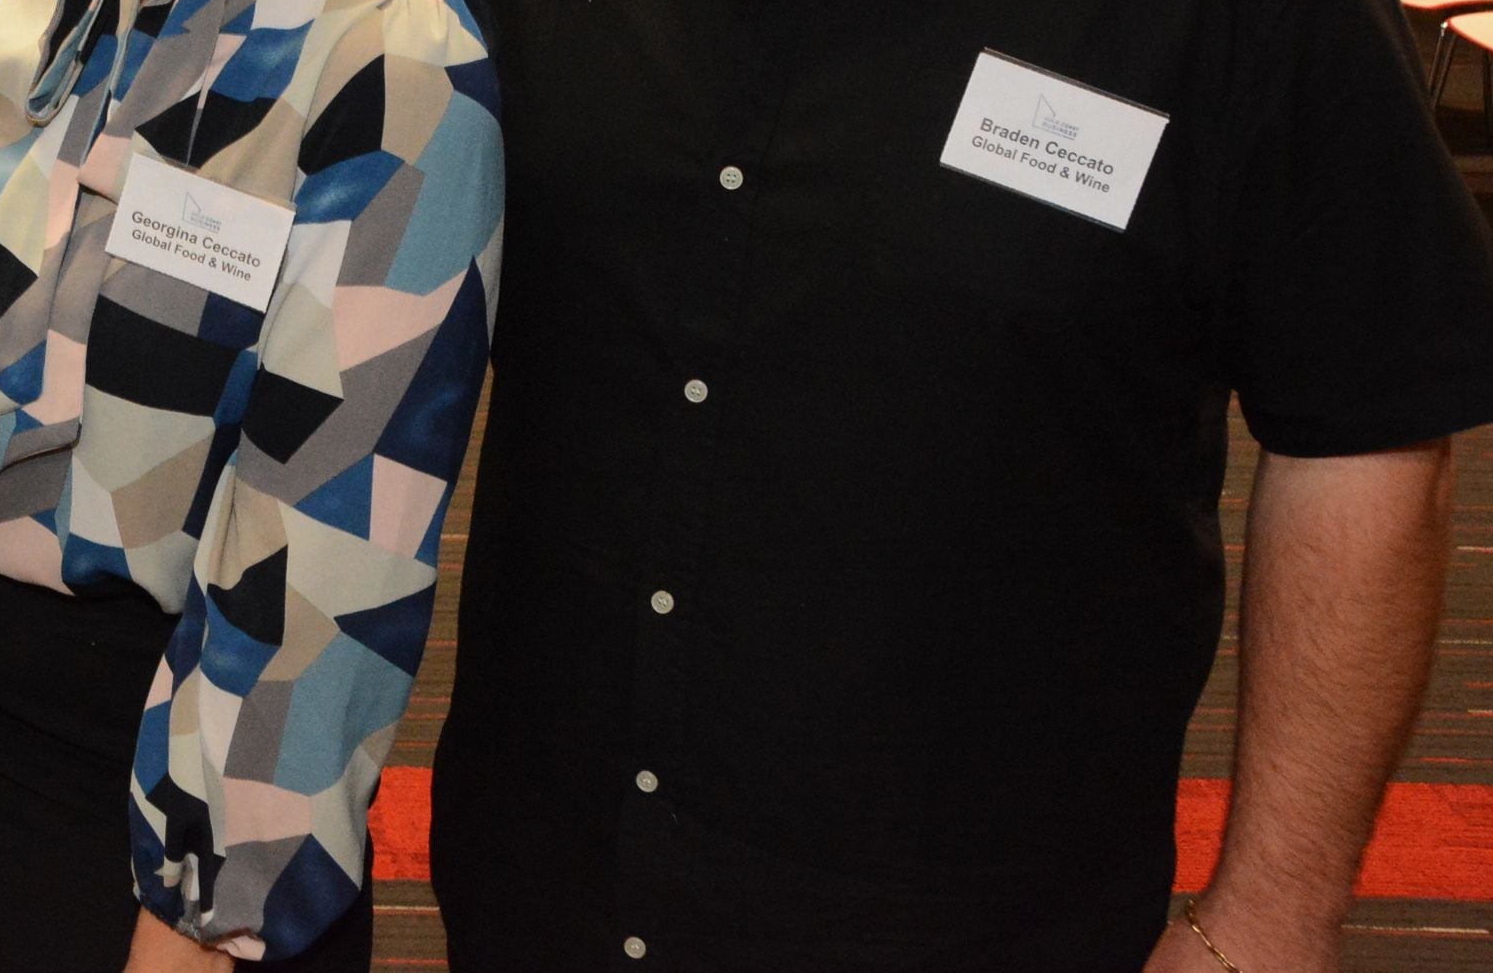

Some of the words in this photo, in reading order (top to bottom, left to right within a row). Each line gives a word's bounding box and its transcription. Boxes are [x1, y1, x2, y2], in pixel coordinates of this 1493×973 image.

[971, 135, 1018, 161] Global
[1019, 152, 1057, 174] Food
[1059, 166, 1070, 179] &
[1075, 171, 1110, 193] Wine
[980, 117, 1041, 150] Braden
[1045, 141, 1114, 175] Ceccato
[131, 211, 198, 244] Georgina
[202, 236, 261, 268] Ceccato
[132, 229, 172, 251] Global
[174, 244, 206, 264] Food
[208, 257, 217, 268] &
[221, 261, 251, 282] Wine
